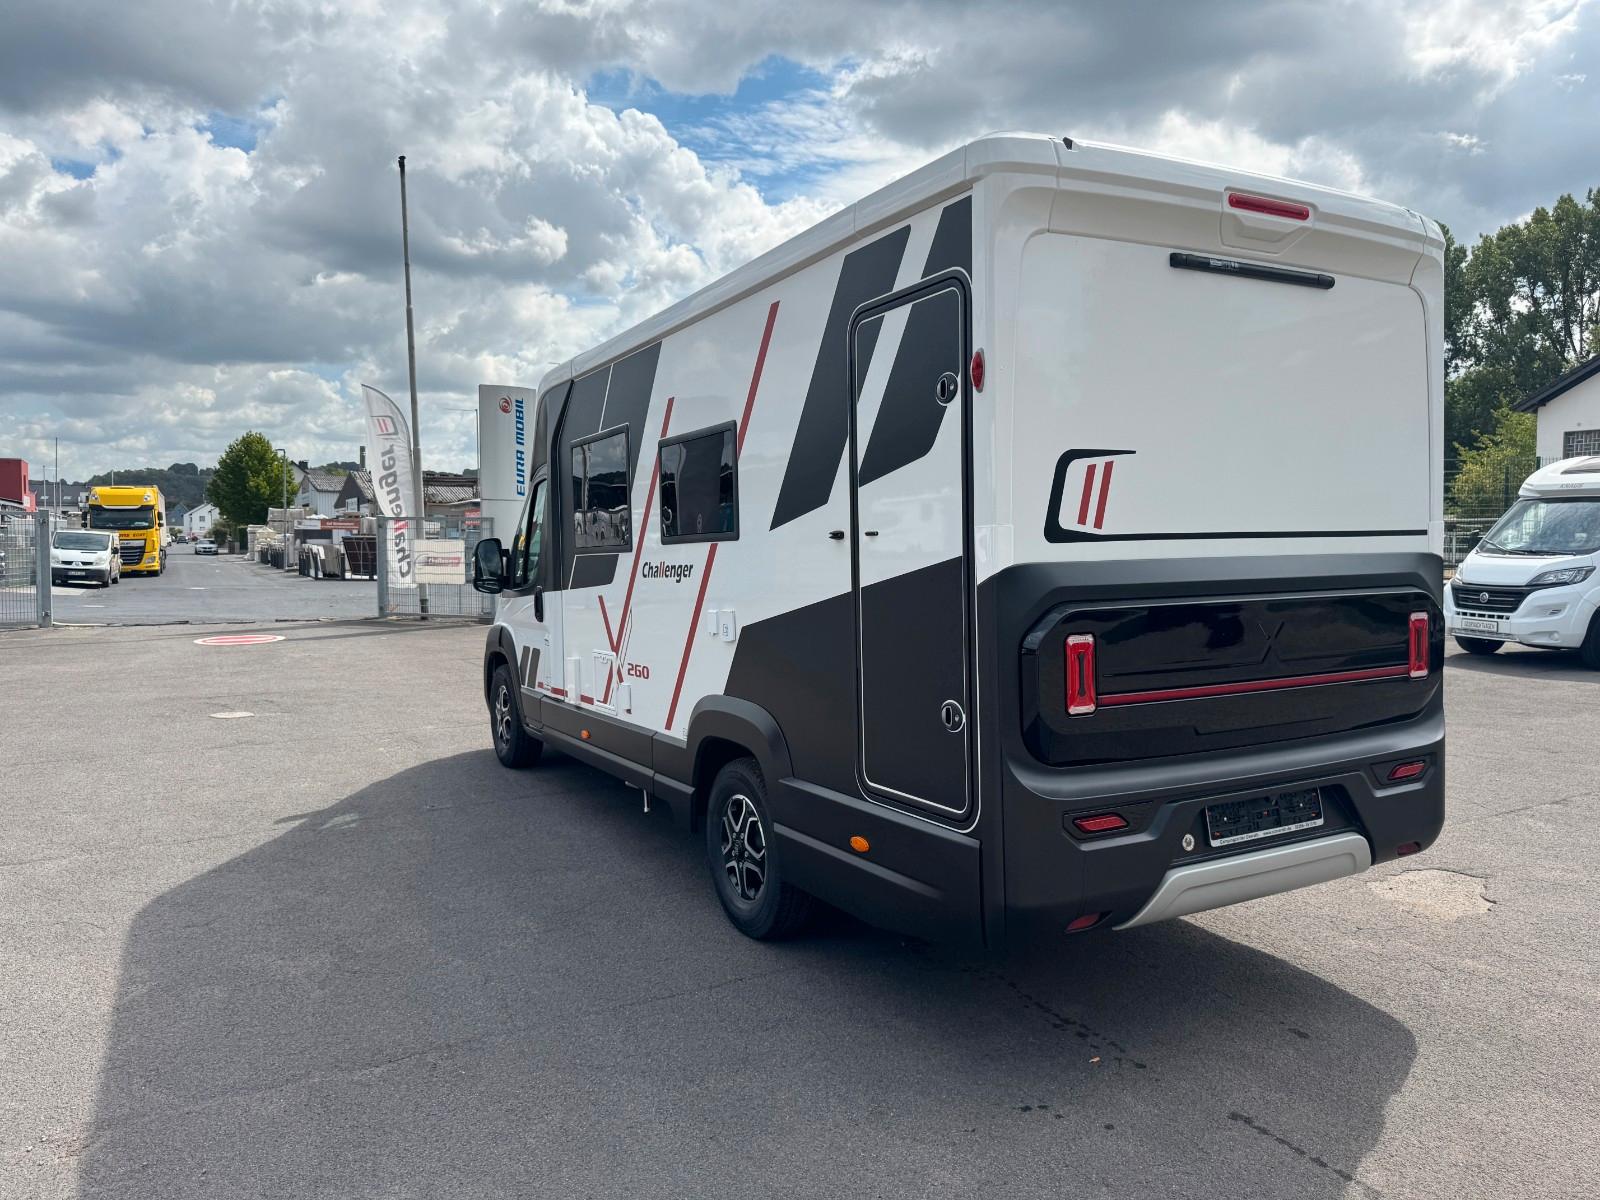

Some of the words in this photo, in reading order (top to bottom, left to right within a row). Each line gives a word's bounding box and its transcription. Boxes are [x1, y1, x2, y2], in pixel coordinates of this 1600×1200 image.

[515, 397, 525, 446] MOBIL
[516, 449, 526, 497] EURA
[641, 560, 694, 584] Challenger
[627, 662, 650, 680] 260
